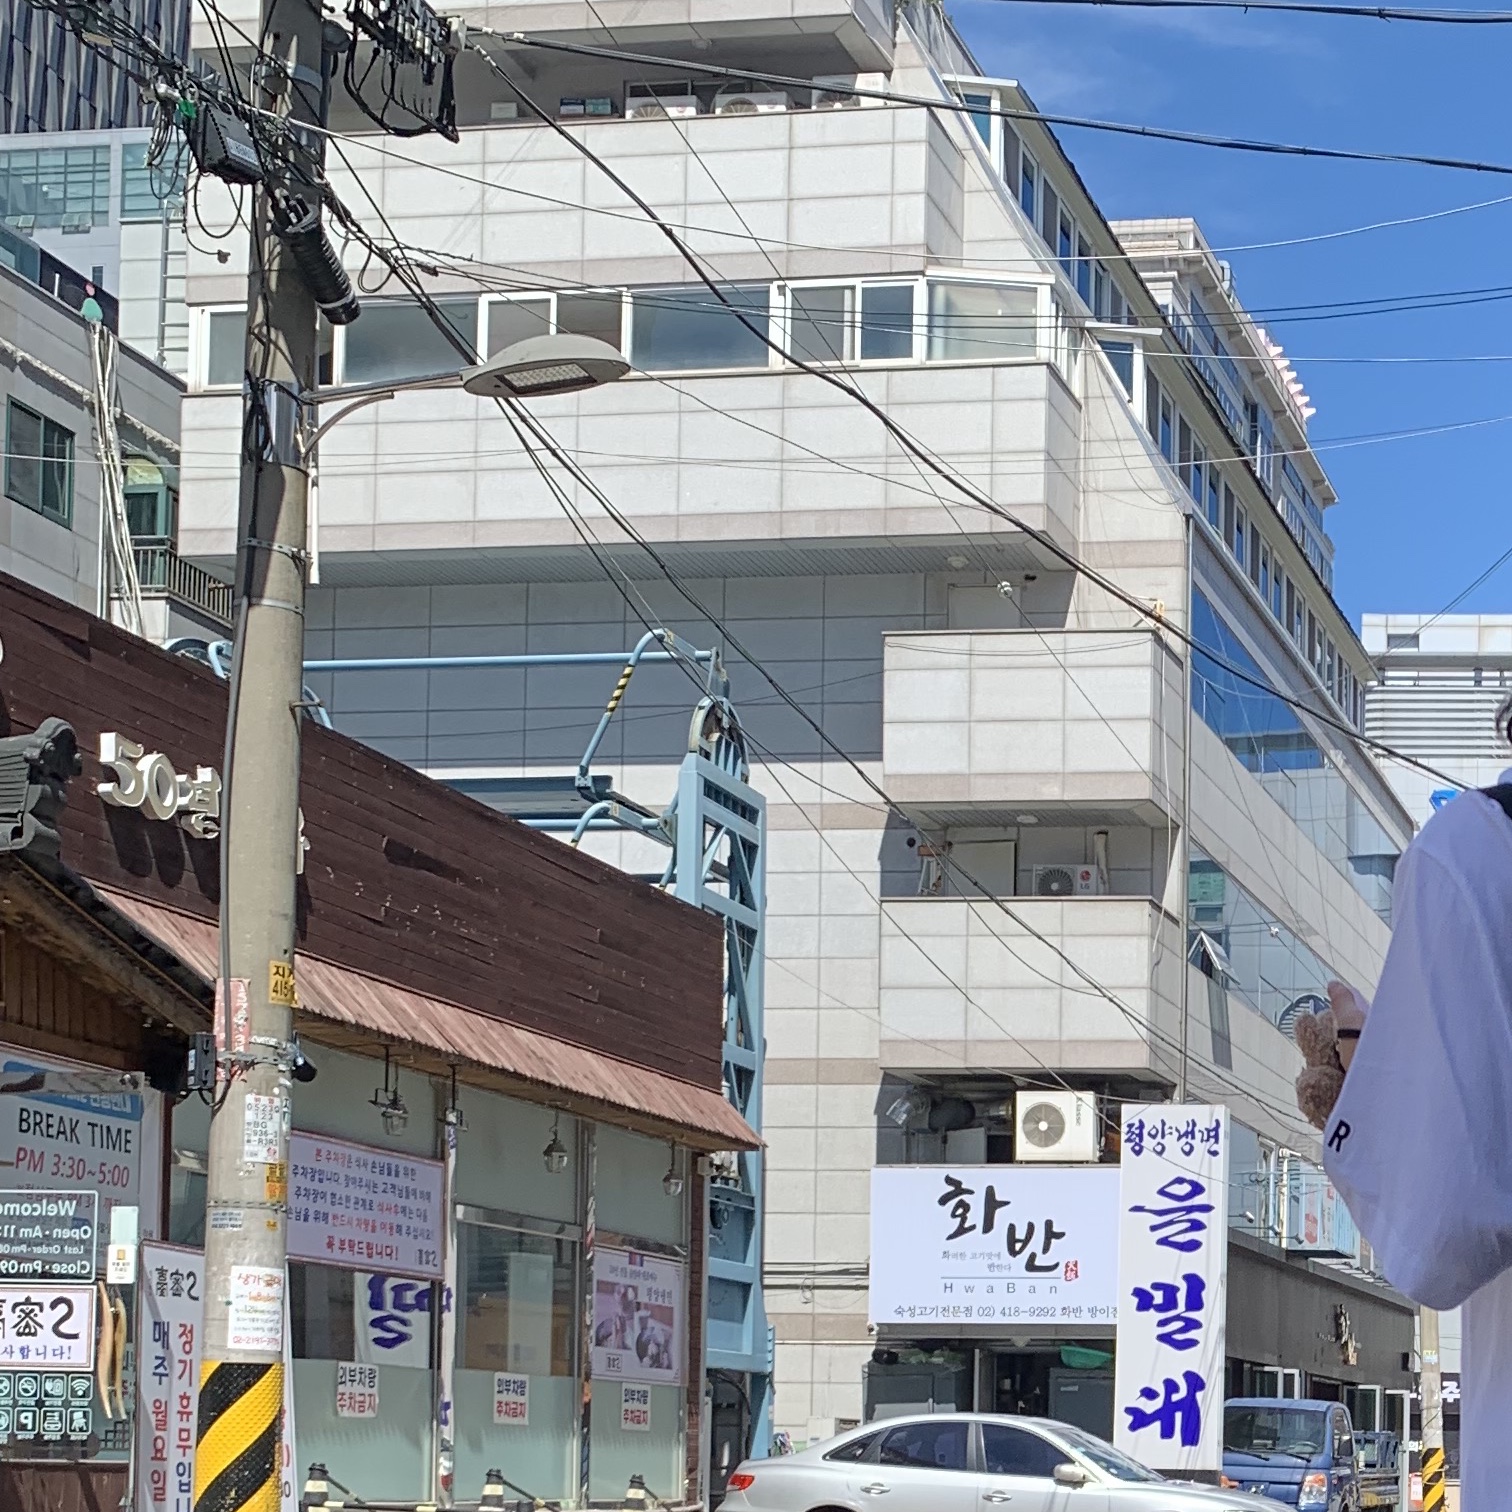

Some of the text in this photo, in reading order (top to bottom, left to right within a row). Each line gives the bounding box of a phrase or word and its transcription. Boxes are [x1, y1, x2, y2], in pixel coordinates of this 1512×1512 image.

[18, 1107, 132, 1154] BREAK TIME
[1124, 1118, 1221, 1157] 평양냉면
[1327, 1120, 1351, 1152] R
[15, 1146, 130, 1188] PM 3:30~5:00
[370, 1159, 400, 1179] 손님들을
[294, 1186, 327, 1204] 주차장이
[286, 1205, 310, 1223] 손님을
[313, 1209, 329, 1225] 위해
[338, 1238, 399, 1262] 부탁드립니다!
[893, 1305, 973, 1318] 숙성고기전문점
[977, 1305, 996, 1318] 02)
[1000, 1305, 1057, 1318] 418-9292
[1060, 1305, 1084, 1318] 화반
[178, 1323, 194, 1387] 정기
[338, 1366, 377, 1389] 외부차량
[496, 1378, 527, 1398] 외부차량
[151, 1321, 170, 1503] 매주 월요일
[337, 1391, 377, 1414] 주차금지
[496, 1400, 526, 1419] 주차금지
[623, 1408, 648, 1426] 주차금지
